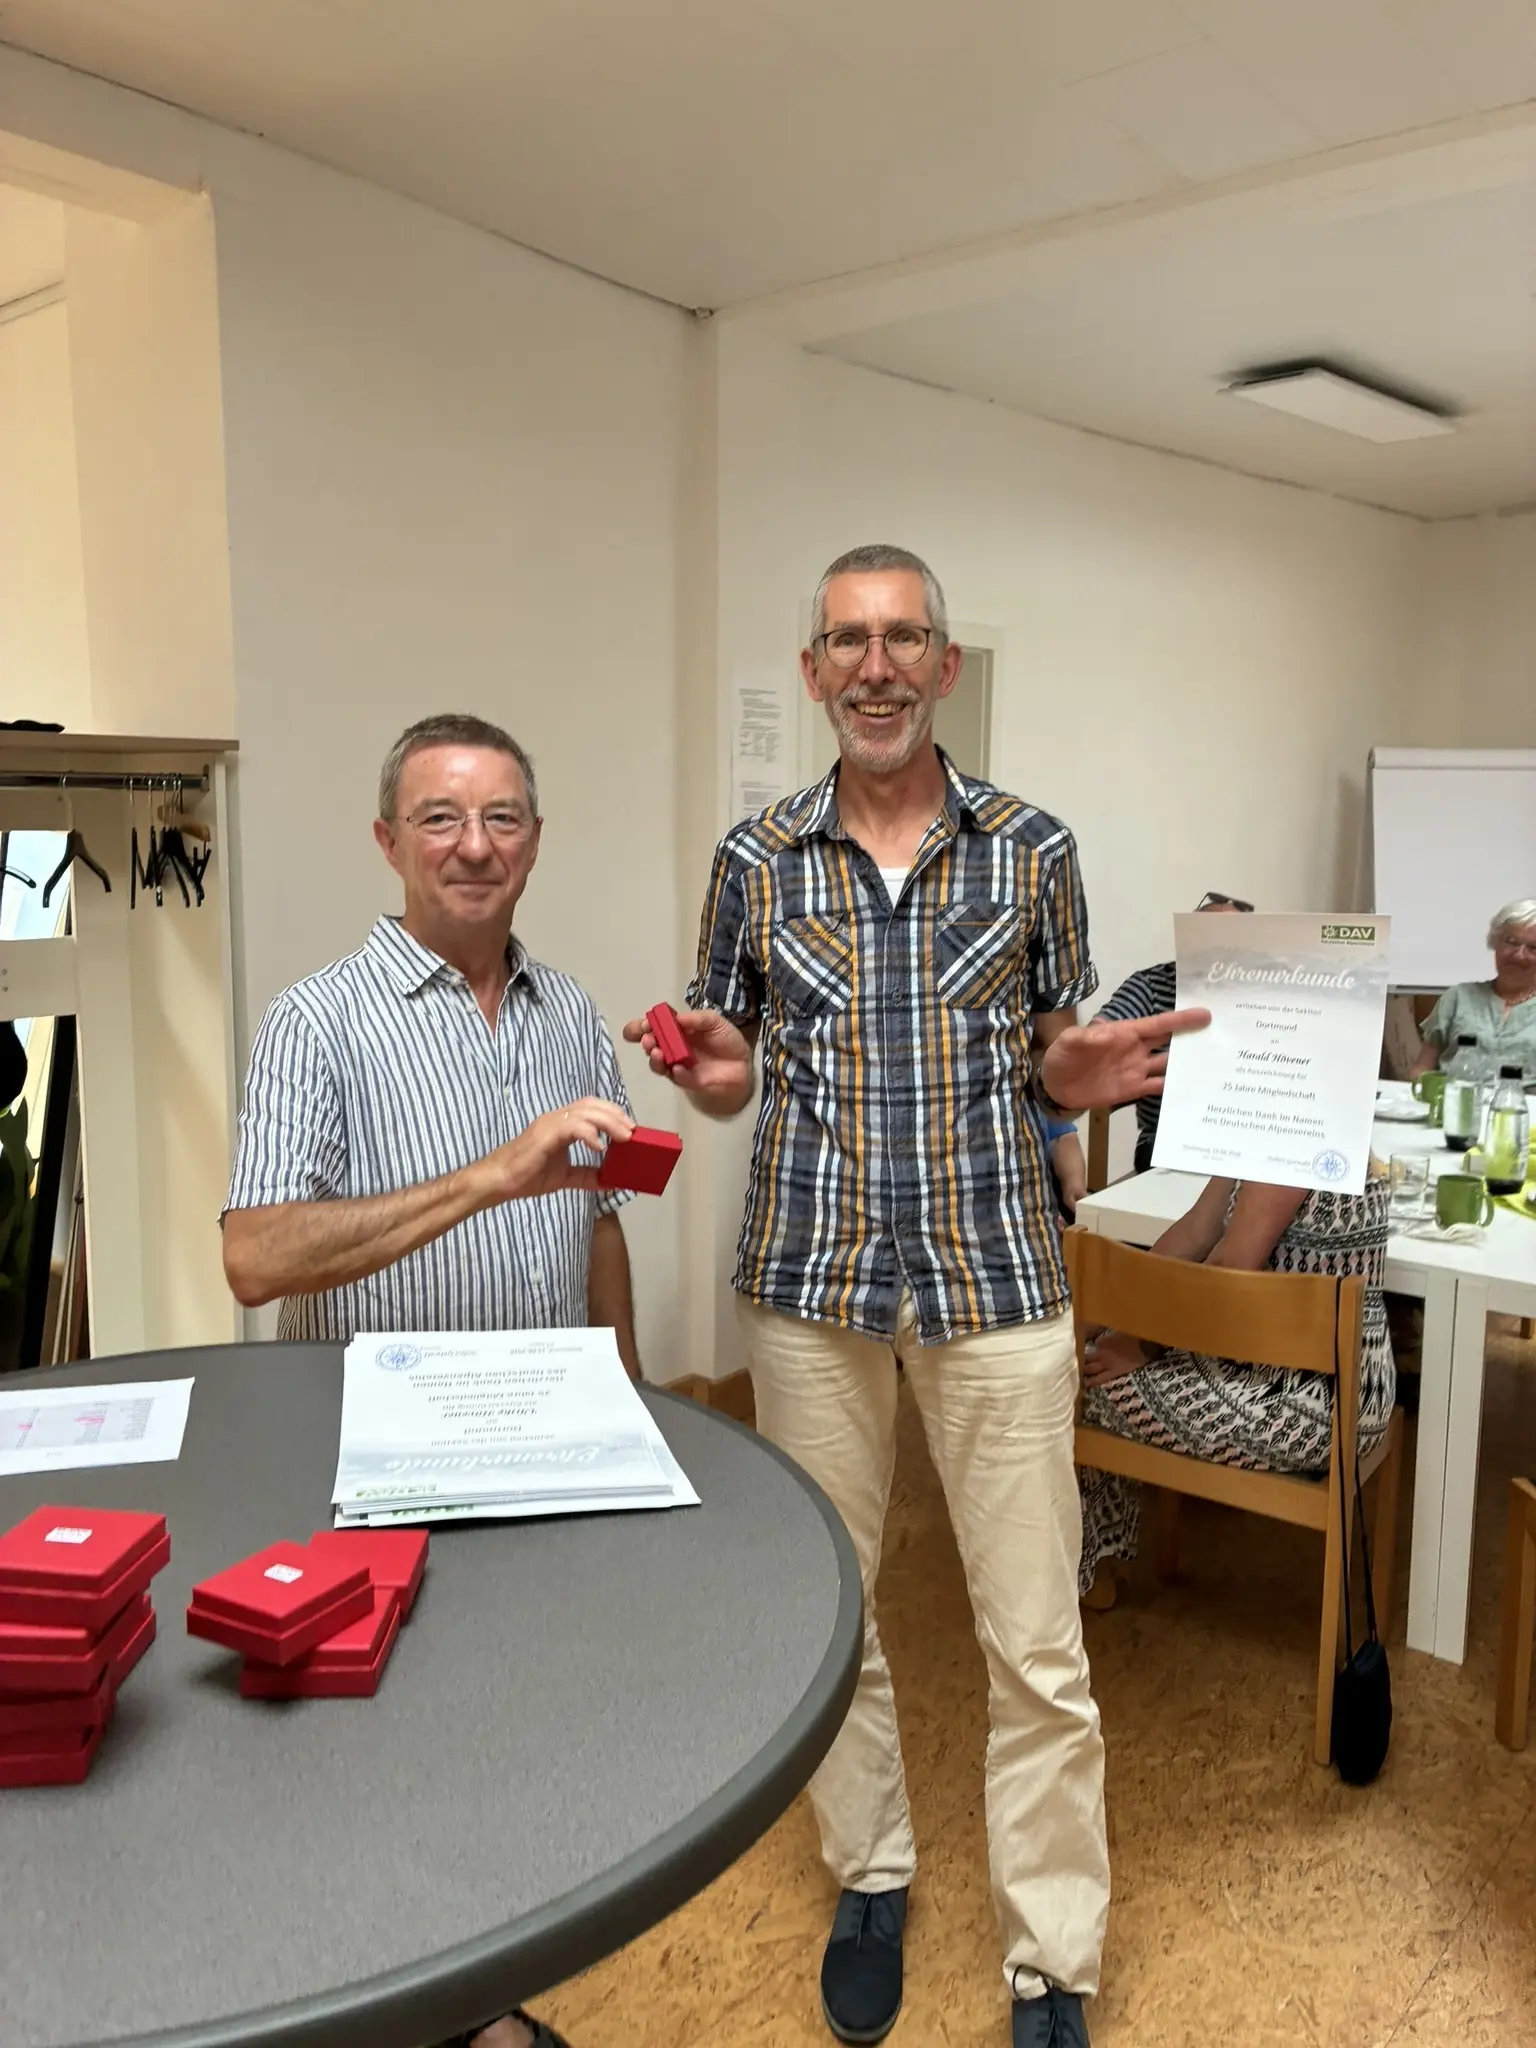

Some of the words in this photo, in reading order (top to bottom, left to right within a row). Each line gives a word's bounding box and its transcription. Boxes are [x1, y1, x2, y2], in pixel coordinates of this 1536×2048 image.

[1340, 927, 1372, 939] DAV
[1207, 961, 1356, 990] Ehrenurkunde
[1256, 1020, 1298, 1032] Dortmund
[1237, 1049, 1271, 1062] Harald
[1222, 1081, 1233, 1092] 25
[1234, 1084, 1256, 1093] Jahre
[1257, 1086, 1316, 1100] Mitgliedschaft
[1207, 1104, 1253, 1118] Herzlichen
[1255, 1110, 1278, 1120] Dank
[1292, 1115, 1324, 1126] Namen
[1202, 1116, 1218, 1124] des
[1220, 1116, 1266, 1131] Deutschen
[1268, 1124, 1326, 1139] Alpenvereins
